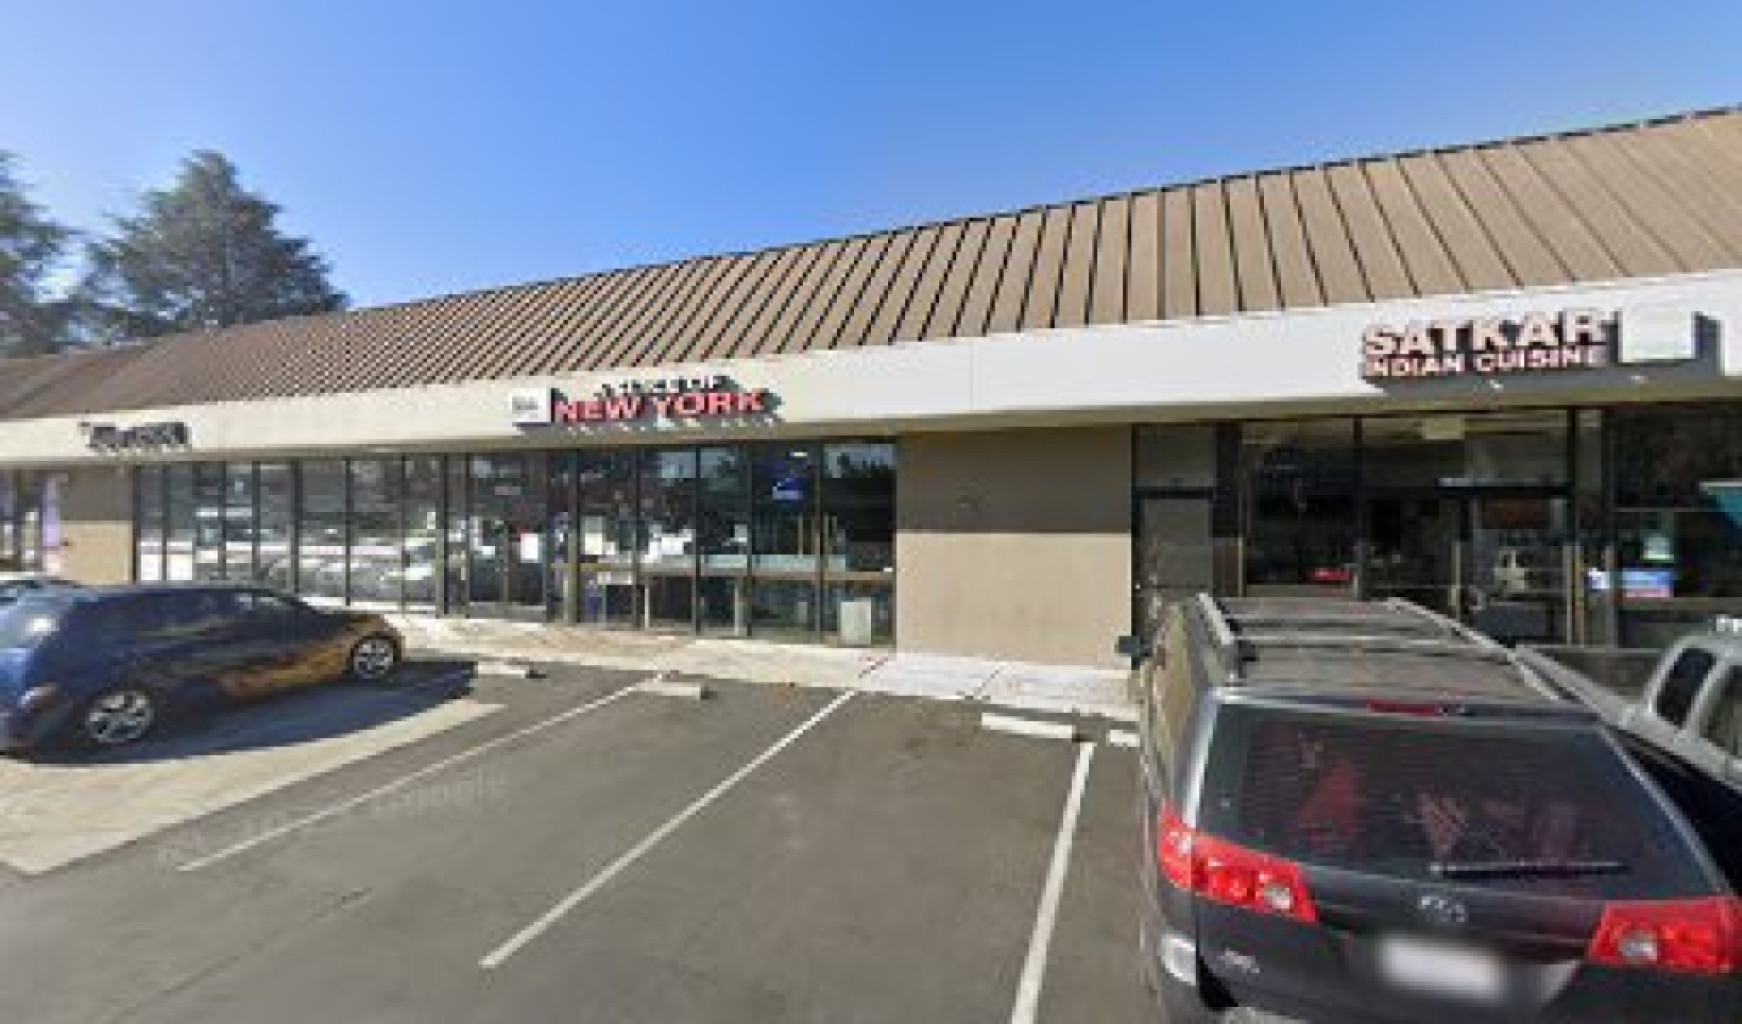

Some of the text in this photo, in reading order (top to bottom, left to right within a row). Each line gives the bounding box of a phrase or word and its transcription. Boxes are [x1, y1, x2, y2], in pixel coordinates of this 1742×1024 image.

[1365, 308, 1607, 355] SATKAR
[1476, 345, 1607, 372] CUISINE
[552, 394, 642, 423] NEW
[652, 387, 766, 416] YORK
